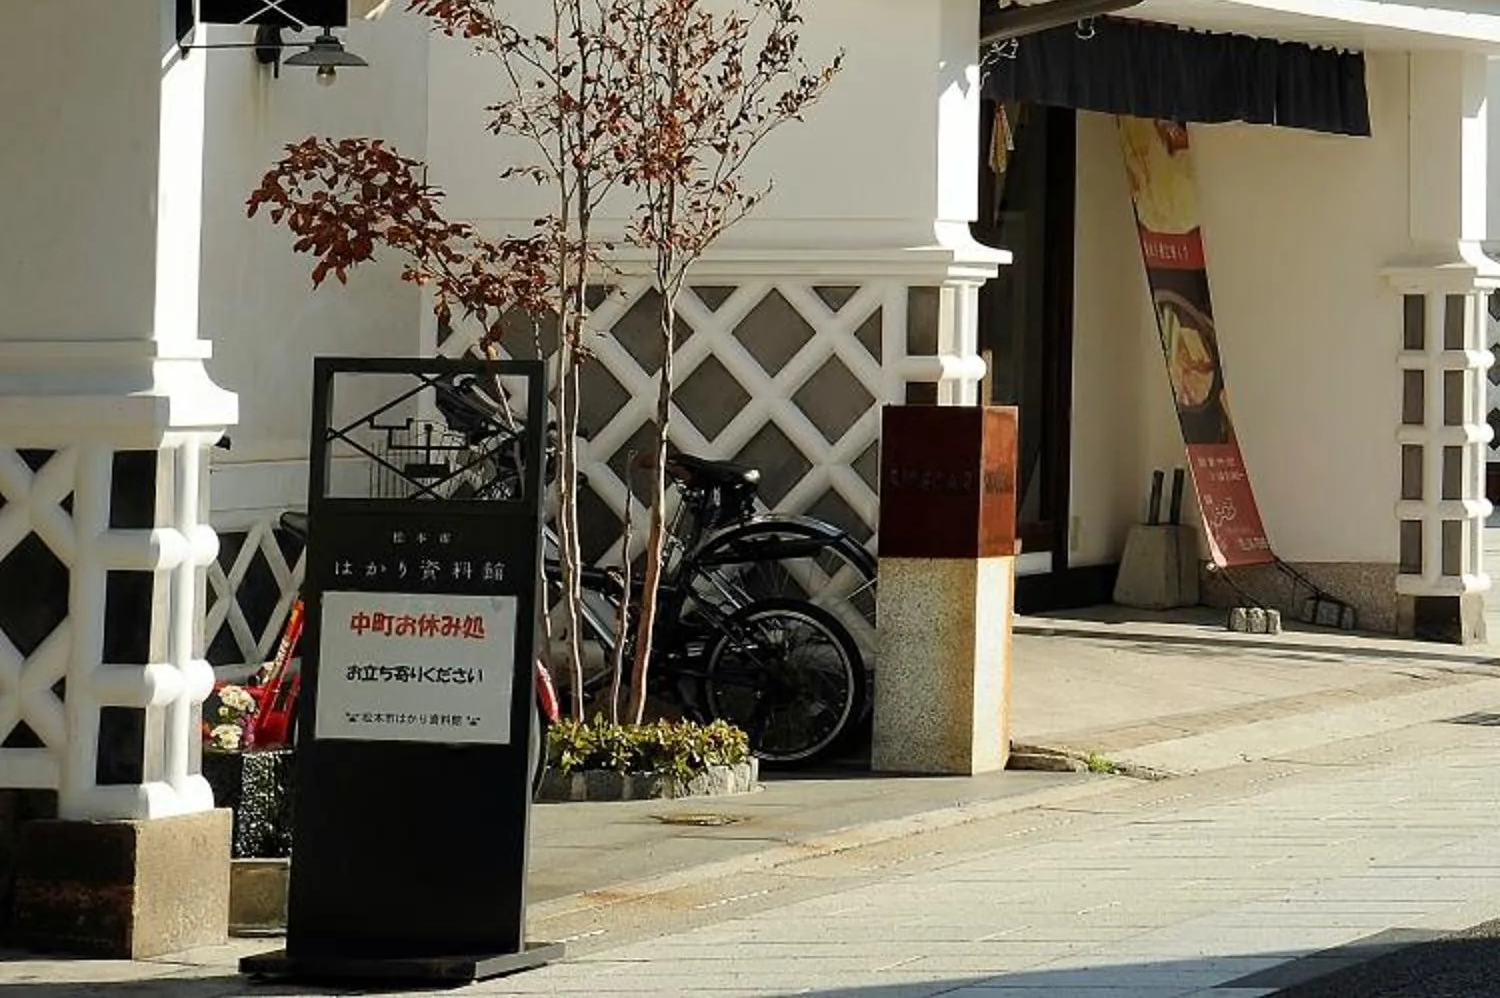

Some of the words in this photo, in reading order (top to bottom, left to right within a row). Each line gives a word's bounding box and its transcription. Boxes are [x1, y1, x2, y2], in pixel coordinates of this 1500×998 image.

[334, 558, 505, 581] はかり資料館
[350, 611, 485, 639] 中町お休み処
[346, 664, 483, 684] お立ち寄りください
